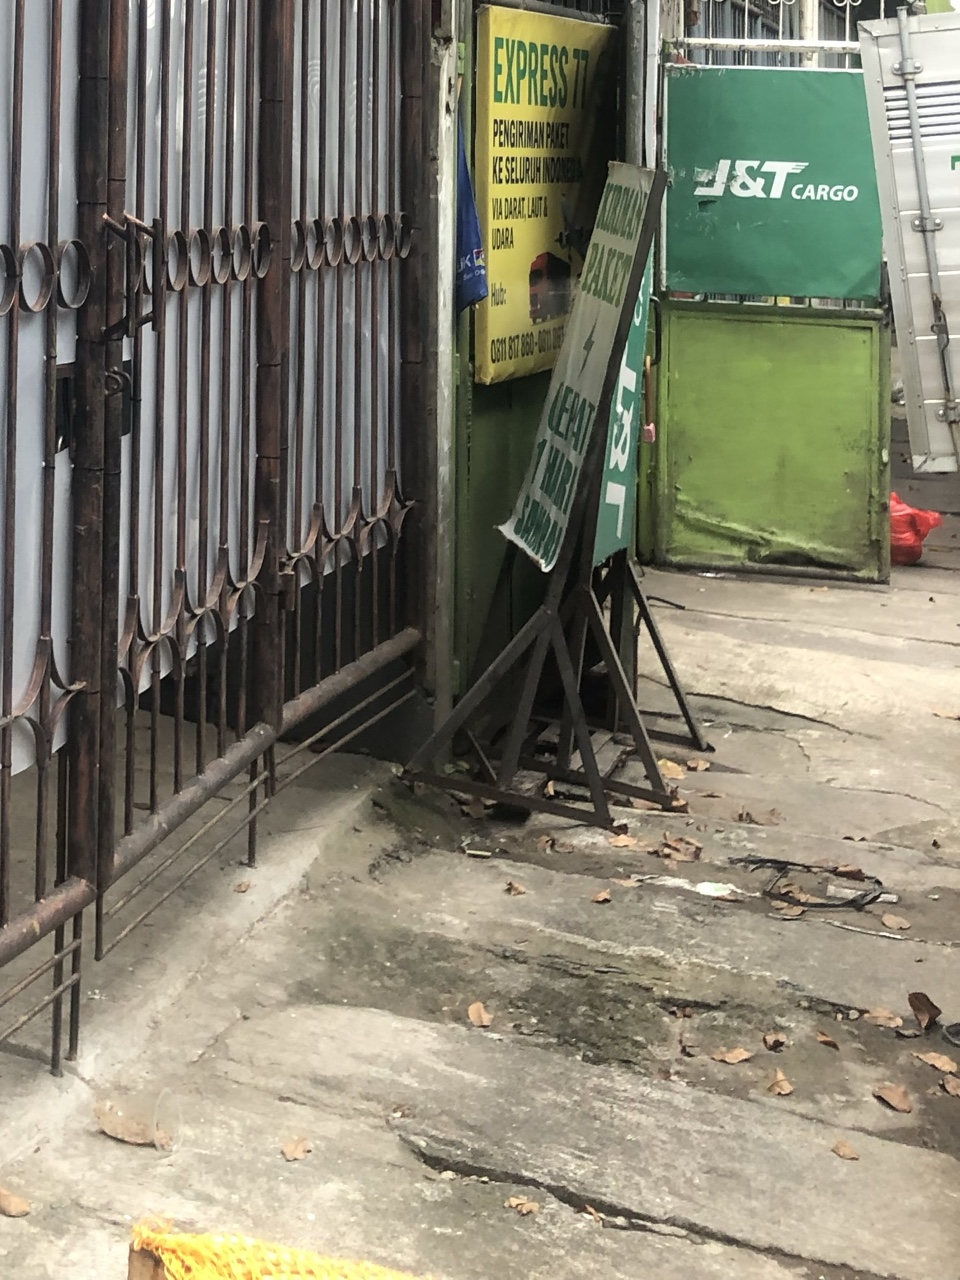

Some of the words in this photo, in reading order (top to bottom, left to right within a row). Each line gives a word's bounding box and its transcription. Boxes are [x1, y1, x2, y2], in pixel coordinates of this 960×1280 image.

[493, 36, 569, 109] EXPRESS
[573, 48, 589, 109] 77
[493, 119, 544, 149] PENGIRIMAN
[546, 122, 569, 150] PAKET
[492, 156, 503, 184] KE
[505, 156, 540, 184] SELURUH
[694, 159, 810, 199] J&T
[791, 184, 859, 202] CARGO
[492, 197, 503, 220] VIA
[504, 197, 526, 221] DARAT,
[527, 197, 542, 218] LAUT
[491, 227, 514, 250] UDARA
[581, 243, 633, 308] PAKET
[548, 382, 596, 456] CEPAT
